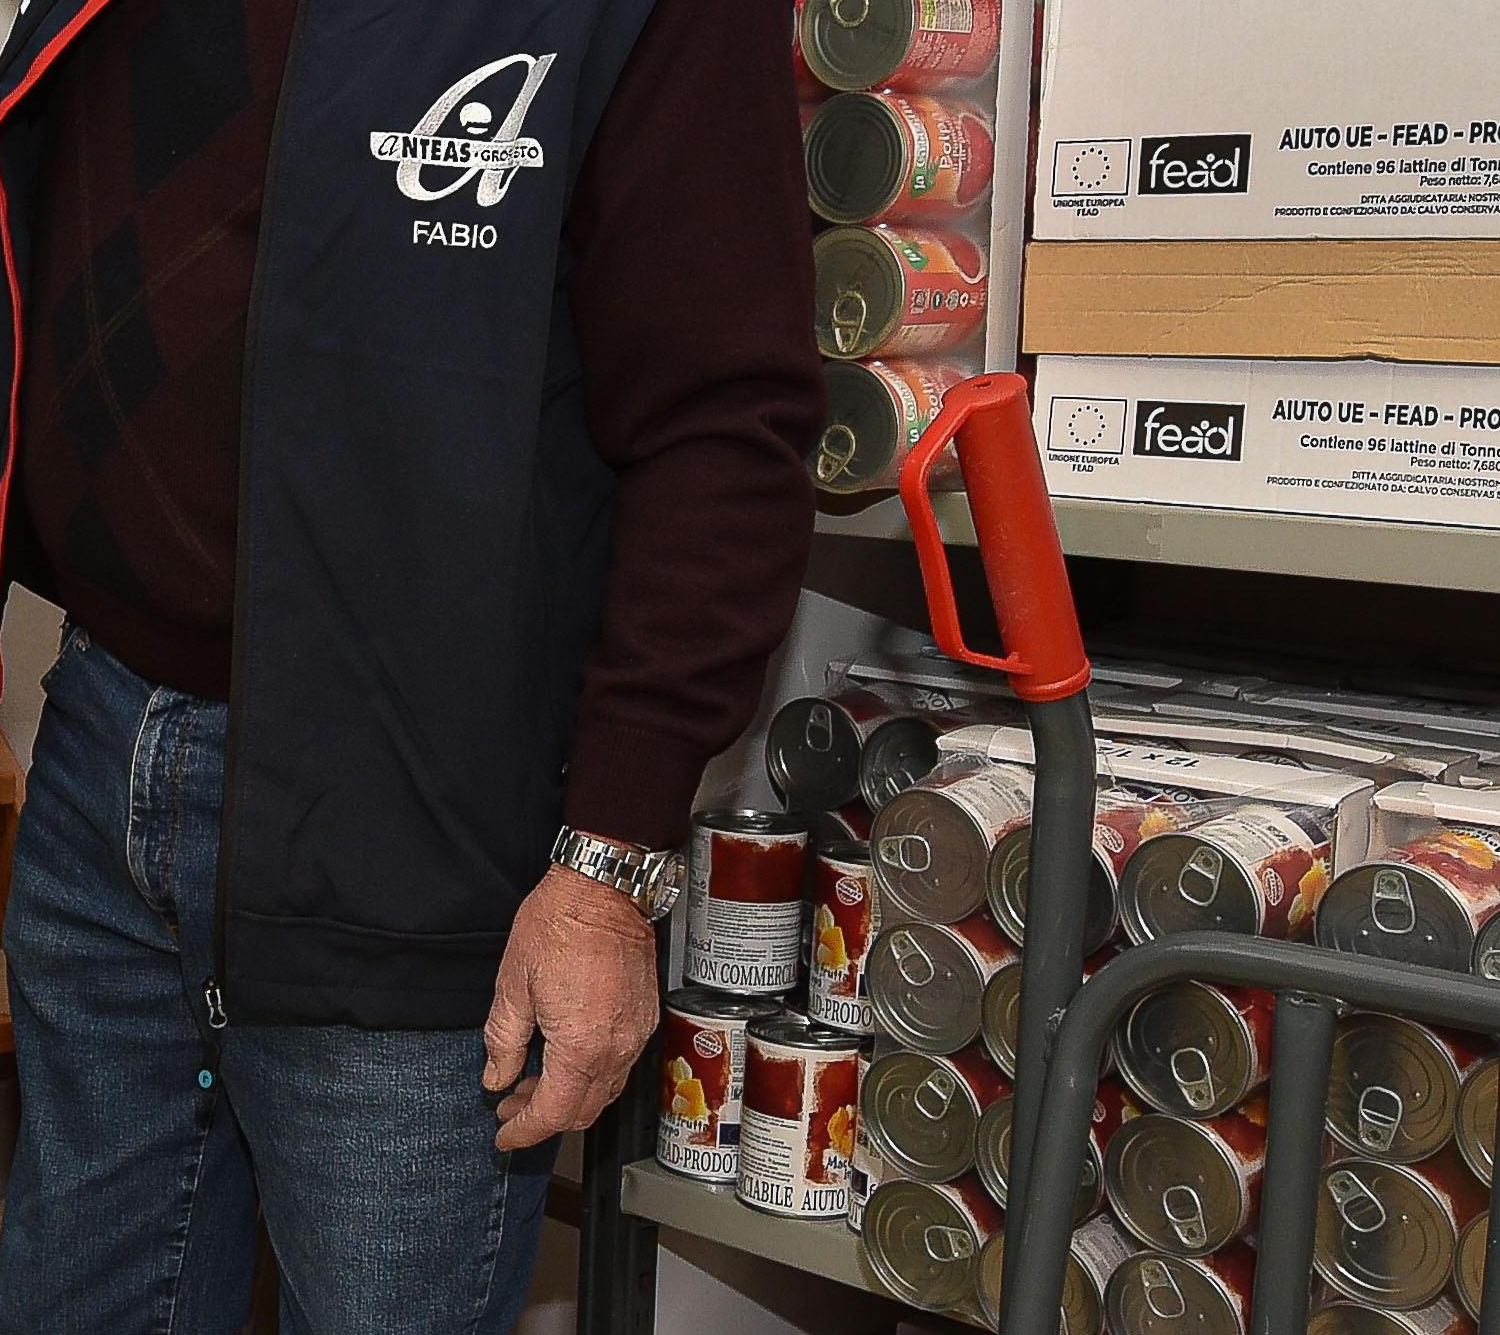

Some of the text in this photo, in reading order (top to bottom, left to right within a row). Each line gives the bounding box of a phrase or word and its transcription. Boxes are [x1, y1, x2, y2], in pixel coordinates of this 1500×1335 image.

[1278, 126, 1341, 150] AIUTO
[1345, 125, 1373, 148] UE
[1392, 123, 1449, 146] FEAD
[1149, 142, 1240, 189] fead
[1308, 159, 1372, 176] Contiene
[1376, 159, 1395, 175] 96
[1399, 158, 1447, 175] lattine
[1451, 158, 1466, 173] di
[1420, 174, 1446, 187] Peso
[412, 220, 498, 249] FABIO
[1271, 399, 1332, 422] AIUTO
[1337, 402, 1365, 423] UE
[1383, 404, 1439, 427] FEAD
[1144, 406, 1234, 456] fead
[1300, 434, 1364, 452] Contiene
[1367, 438, 1387, 452] 96
[1390, 438, 1437, 455] lattine
[1440, 440, 1456, 456] di
[800, 1188, 846, 1212] AIUTO
